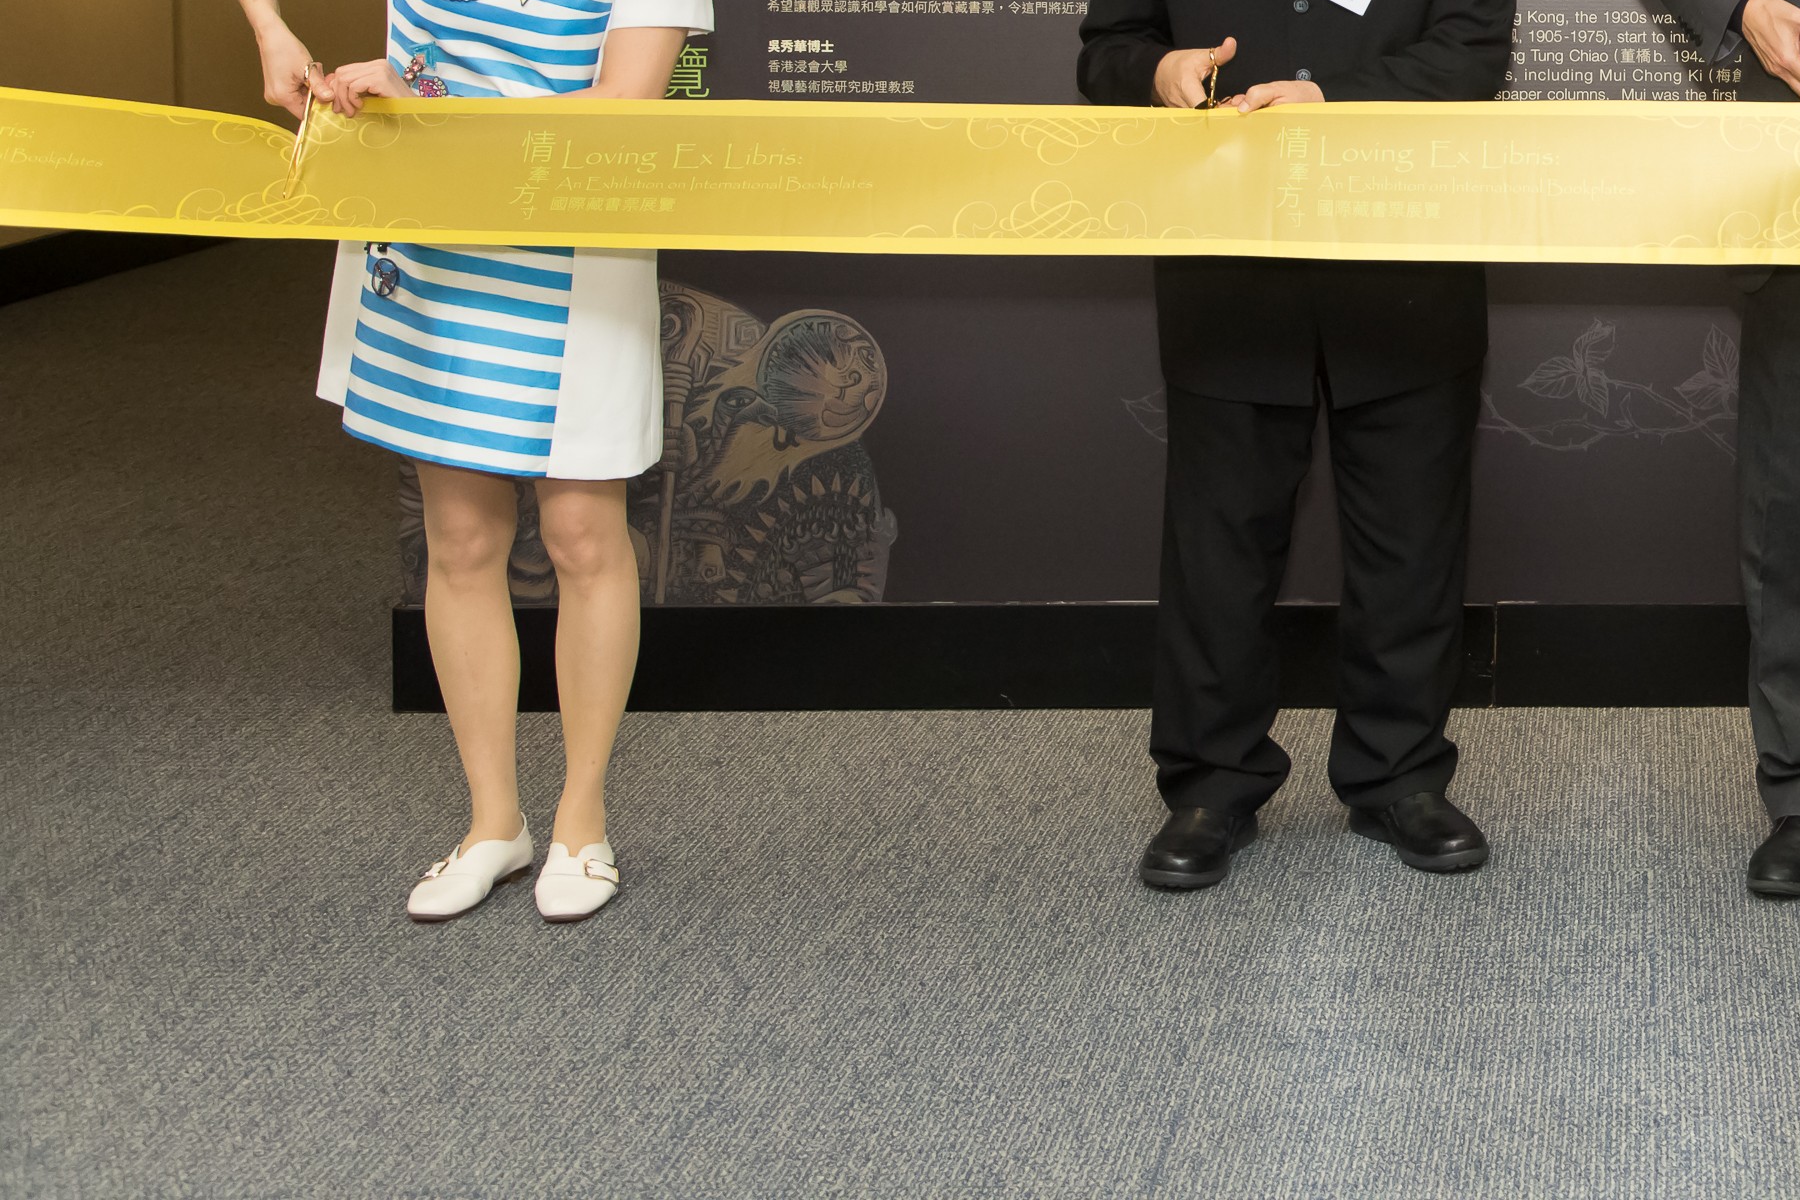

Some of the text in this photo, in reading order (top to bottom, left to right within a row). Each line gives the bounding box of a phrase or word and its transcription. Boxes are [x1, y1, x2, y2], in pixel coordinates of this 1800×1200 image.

[768, 40, 834, 53] 吳秀華博士
[768, 60, 847, 73] 香港浸會大學
[768, 80, 914, 93] 視覺藝術院研究助理教授
[10, 147, 104, 170] Bookplates
[562, 139, 803, 173] Loving Ex Libris:
[1319, 136, 1560, 172] Loving Ex Libris:
[556, 176, 873, 194] An Exhibition on International Bookplates
